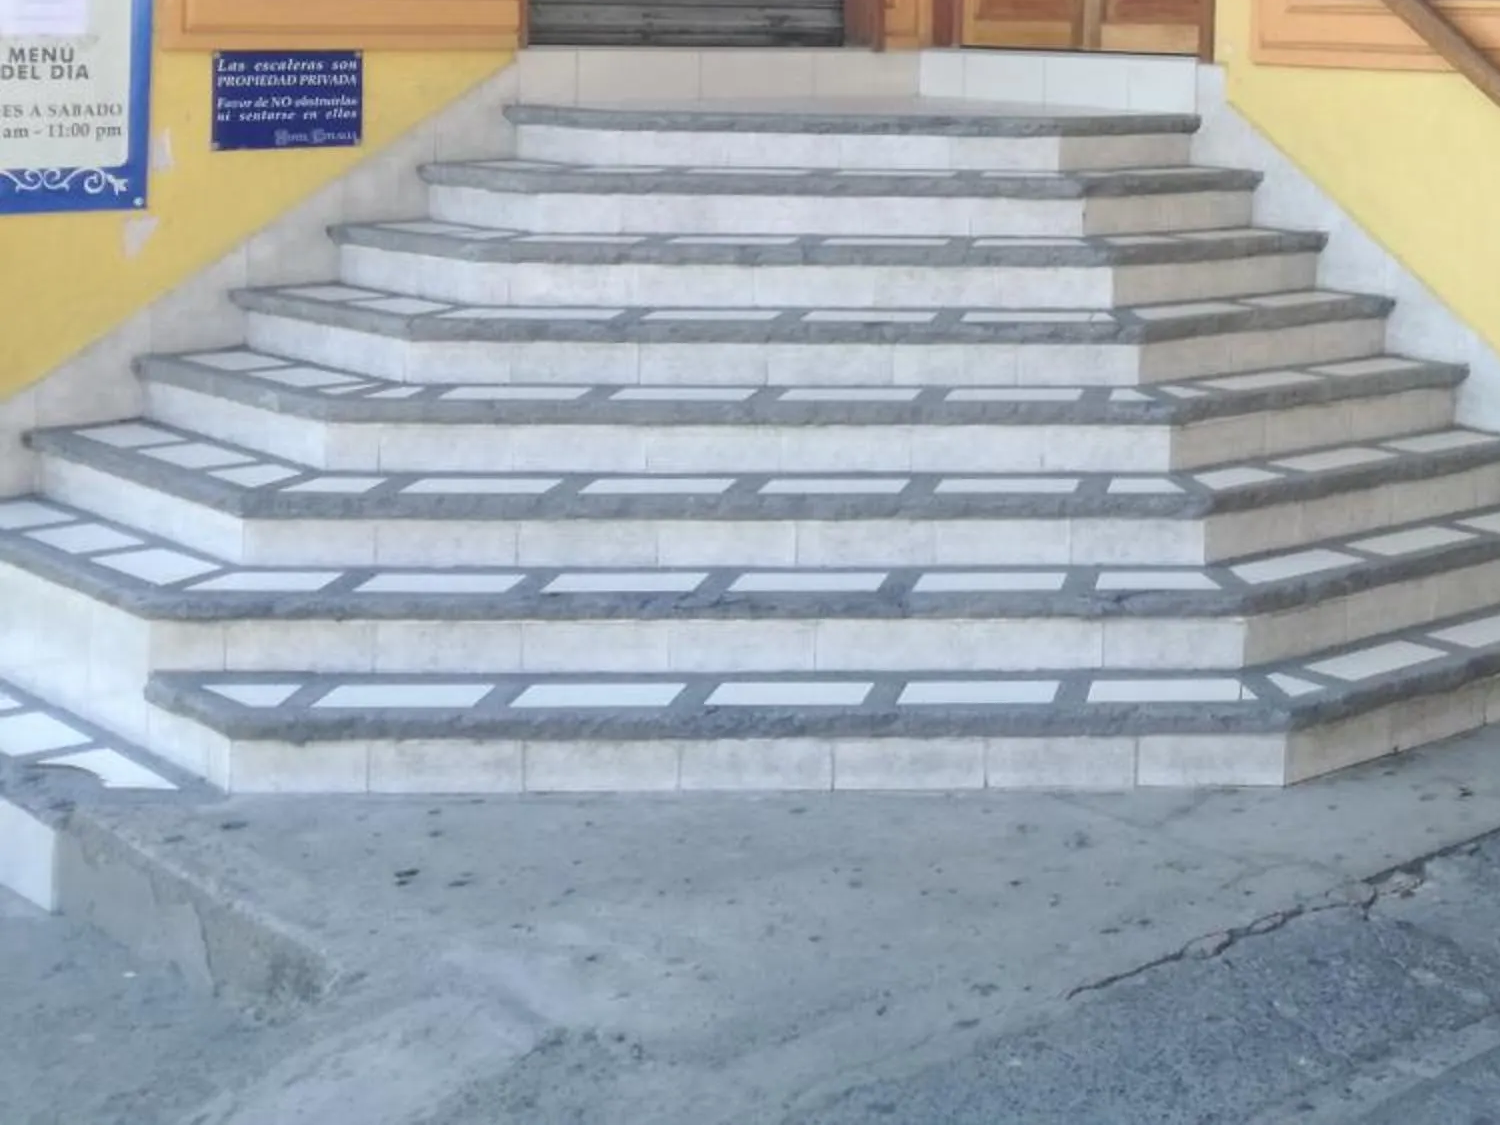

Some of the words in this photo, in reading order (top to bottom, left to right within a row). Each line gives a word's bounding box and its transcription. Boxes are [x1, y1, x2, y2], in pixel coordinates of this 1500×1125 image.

[1, 64, 41, 80] DEL
[217, 58, 245, 72] Las
[254, 58, 324, 72] escaleras
[331, 60, 358, 70] son
[217, 74, 296, 87] PROPIEDAD
[300, 74, 357, 87] PRIVADA
[254, 96, 268, 108] de
[270, 95, 293, 108] NO
[30, 104, 41, 117] A
[47, 103, 123, 118] SABADO
[217, 110, 229, 121] ni
[239, 110, 296, 121] sentarse
[303, 110, 318, 120] en
[325, 108, 358, 120] ellas
[2, 126, 29, 138] am
[48, 122, 90, 138] 11:00
[95, 125, 122, 142] pm
